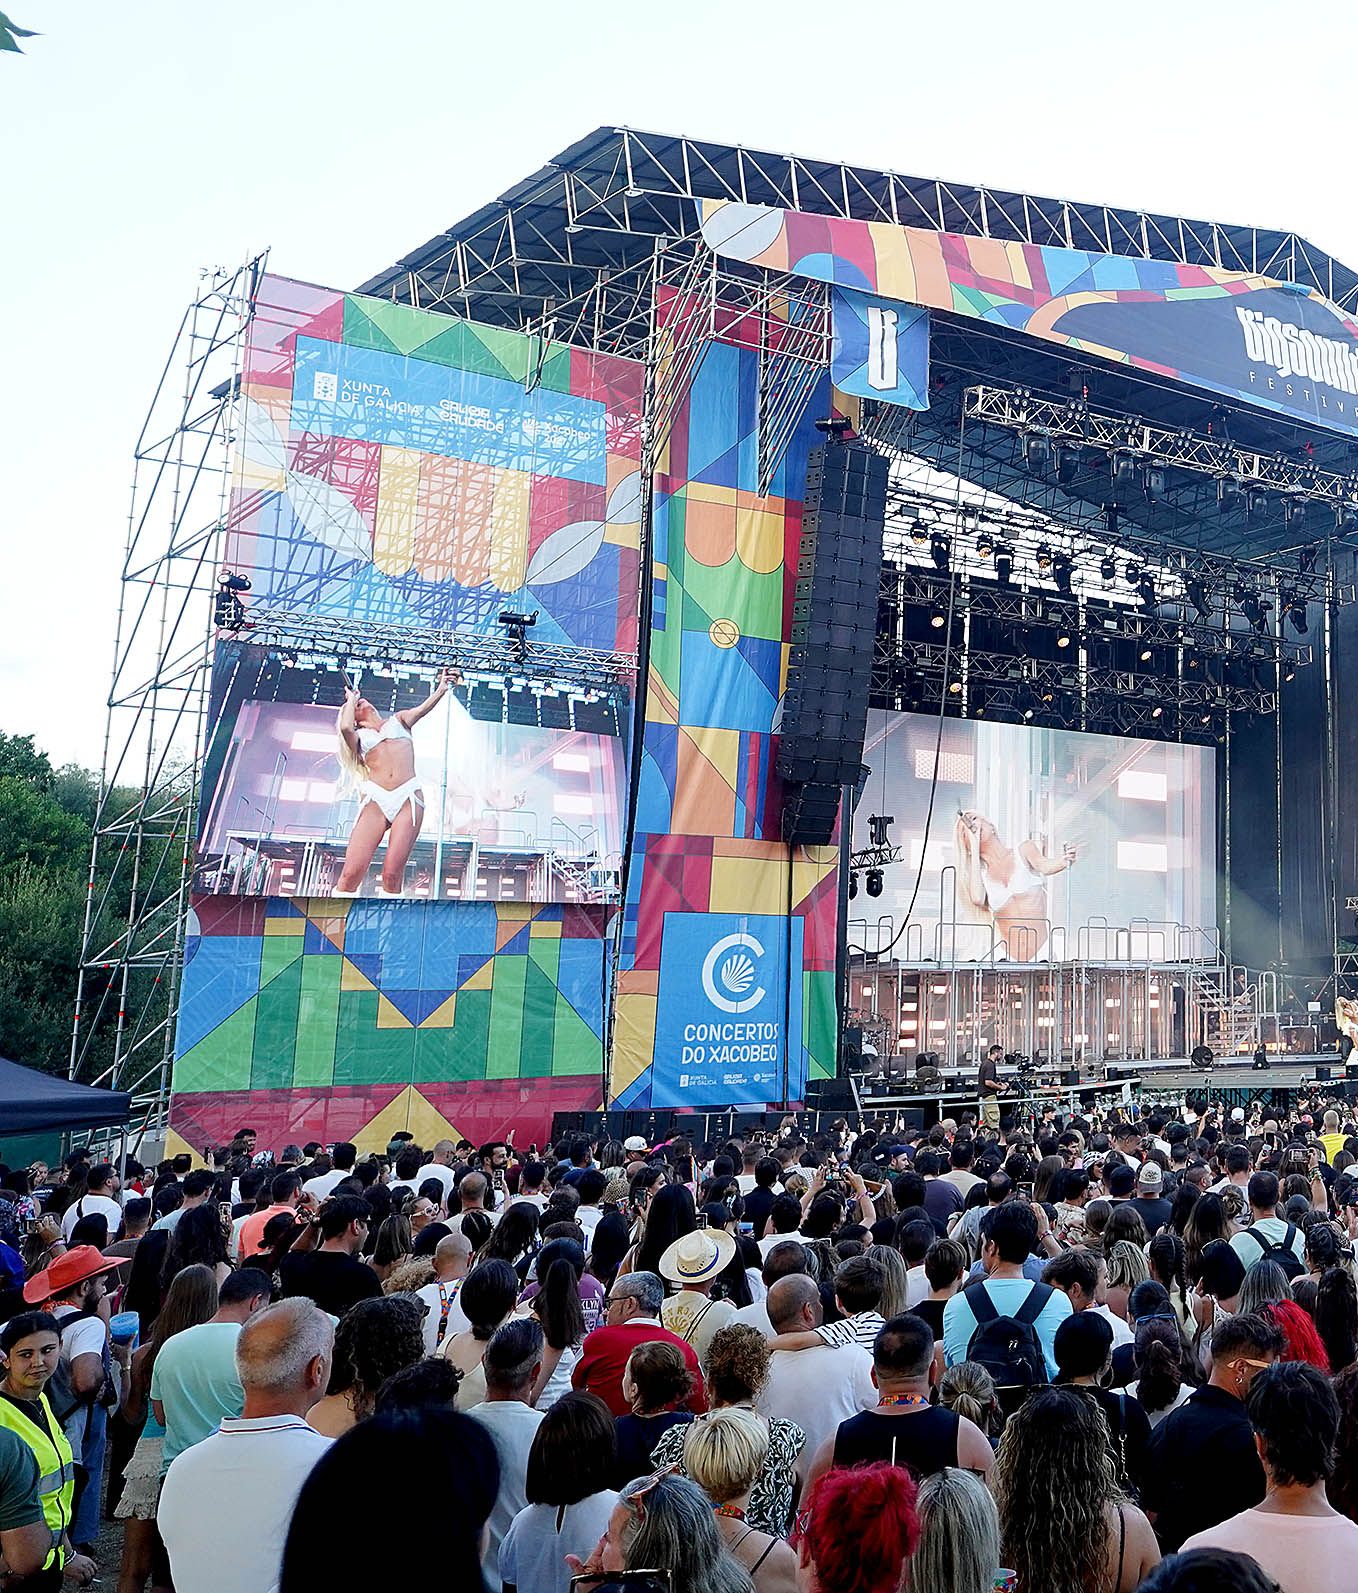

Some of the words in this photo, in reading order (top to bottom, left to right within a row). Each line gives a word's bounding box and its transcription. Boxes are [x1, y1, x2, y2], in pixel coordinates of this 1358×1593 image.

[342, 378, 392, 398] XUNTA
[341, 391, 360, 403] DE
[364, 395, 422, 417] GALICIA
[681, 1046, 706, 1064] DO
[708, 1044, 778, 1064] XACOBEO
